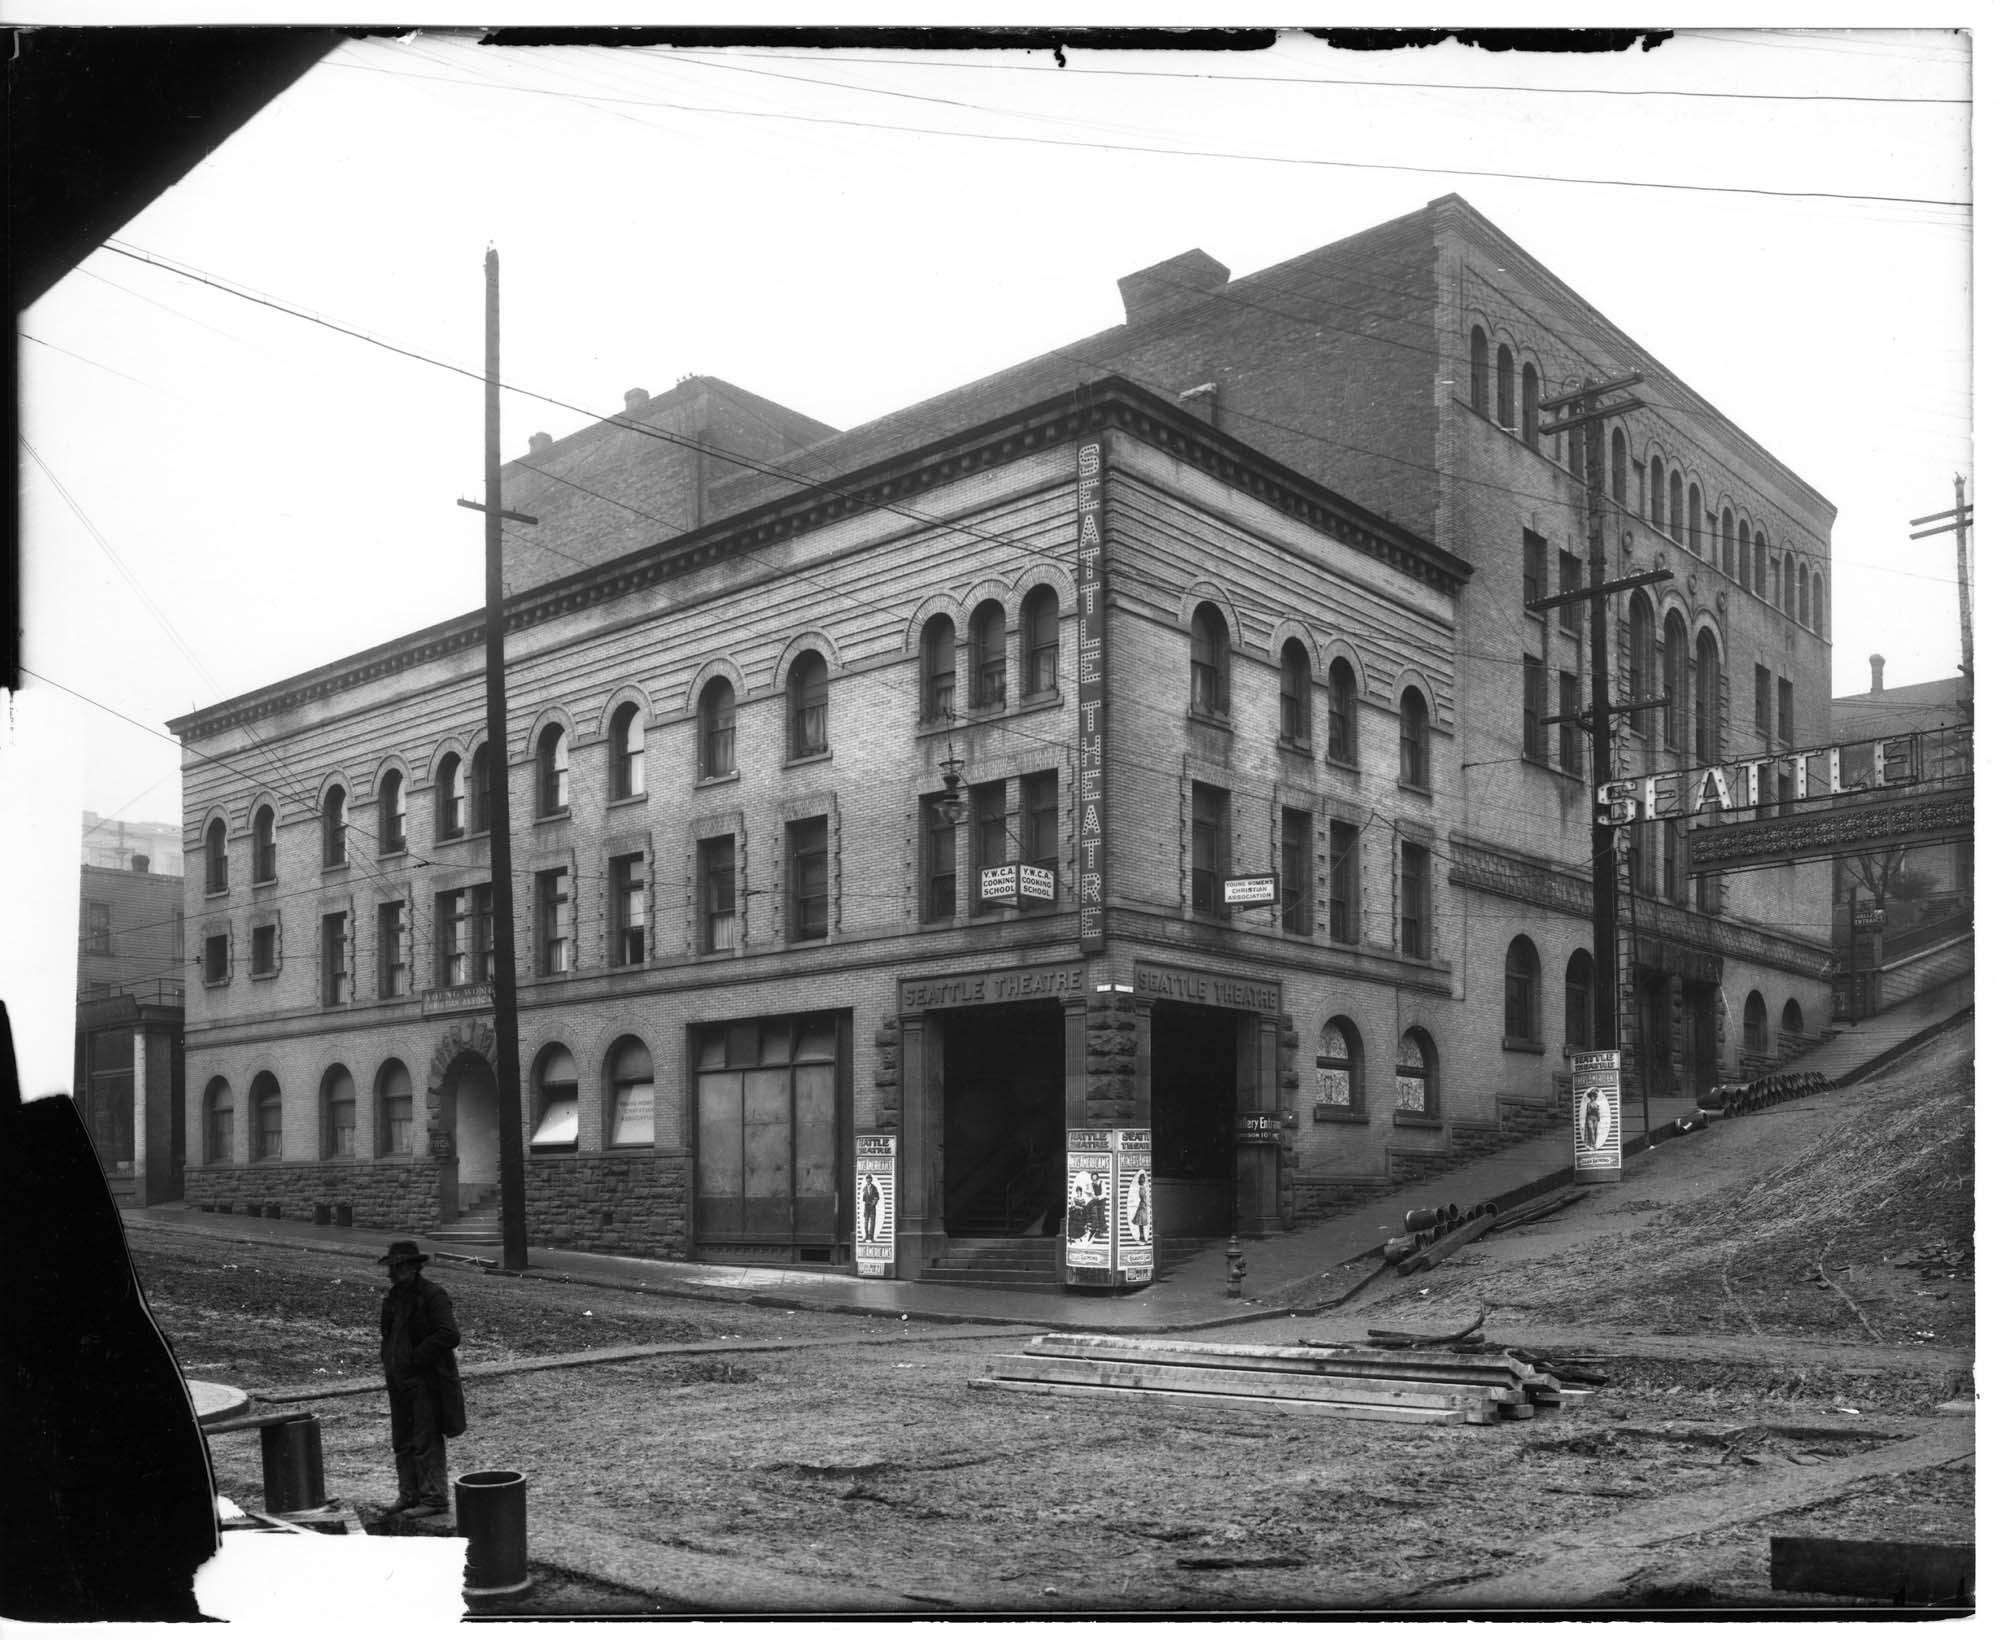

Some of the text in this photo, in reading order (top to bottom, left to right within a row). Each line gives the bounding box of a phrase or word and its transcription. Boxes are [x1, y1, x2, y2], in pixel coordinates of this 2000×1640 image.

[1079, 443, 1102, 939] SEATTLE THEATRE
[1598, 734, 1918, 826] SEATTLE
[983, 877, 1015, 888] COOKING
[1021, 876, 1052, 889] COOKING
[983, 886, 1015, 897] SCHOOL
[1023, 885, 1051, 897] SCHOOL
[1231, 886, 1268, 894] CHRISTIAN
[1227, 892, 1271, 901] ASSOCIATION
[905, 968, 1082, 1007] SEATTLE THEATRE
[1137, 968, 1278, 1010] SEATTLE THEATRE
